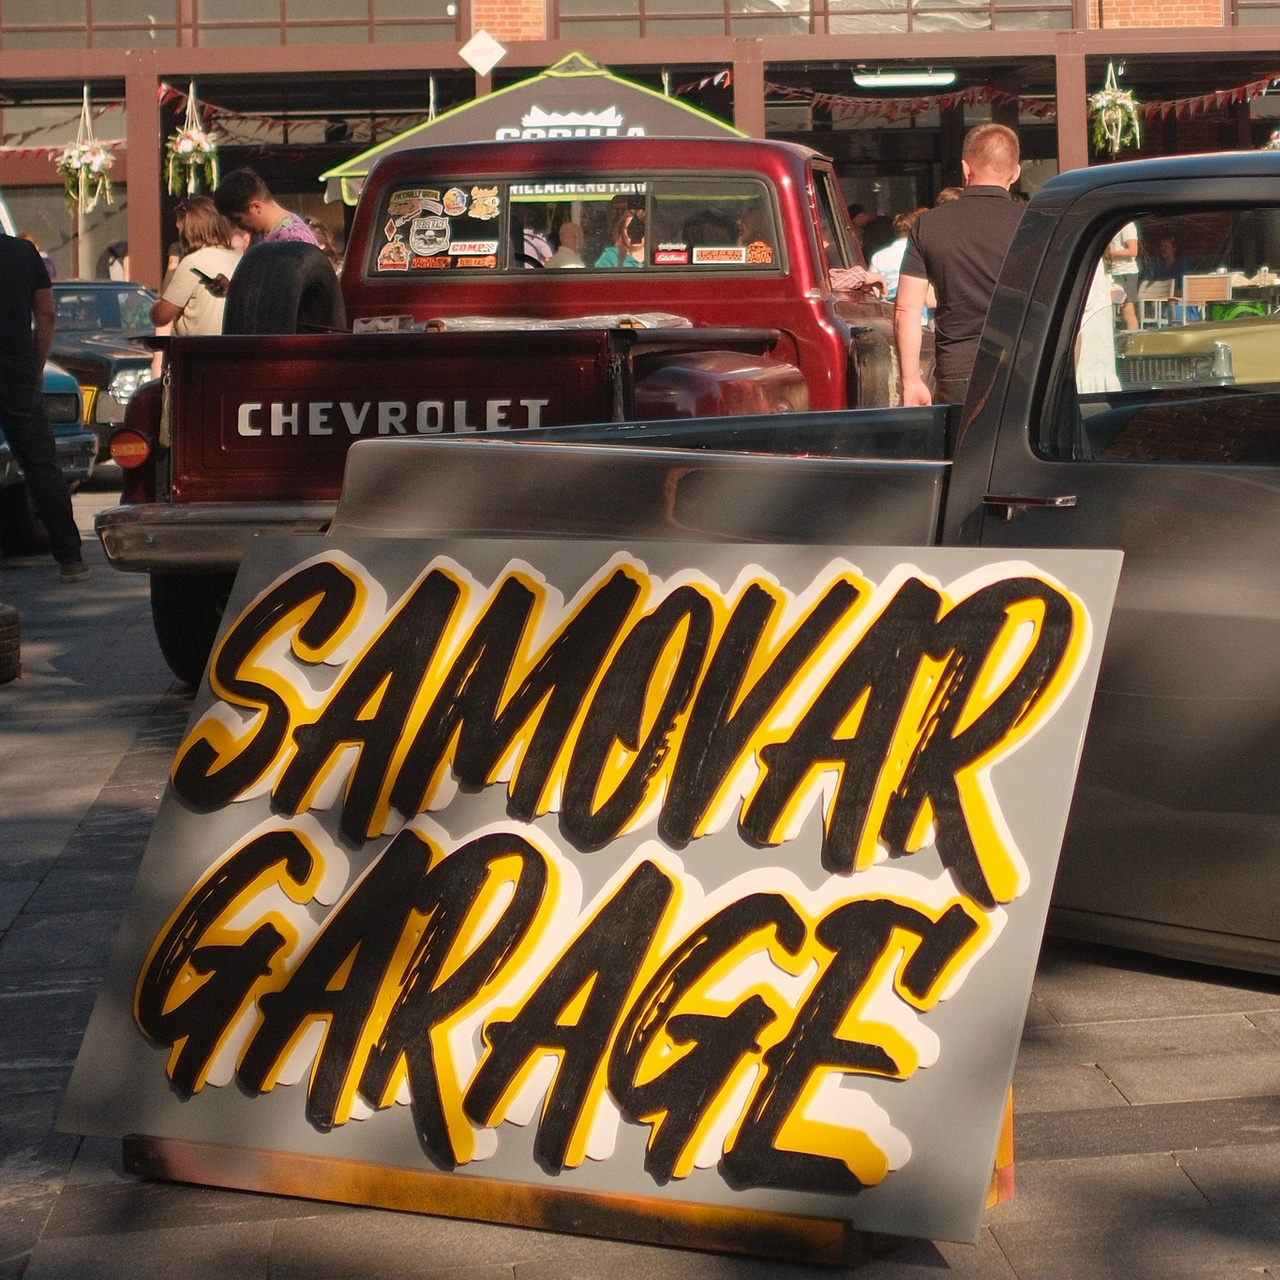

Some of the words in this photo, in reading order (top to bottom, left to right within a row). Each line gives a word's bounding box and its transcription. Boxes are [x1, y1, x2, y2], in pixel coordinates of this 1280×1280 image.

[451, 243, 485, 252] COMP
[237, 398, 549, 437] CHEVROLET
[171, 556, 1093, 906] SAMOVAR
[134, 827, 1000, 1191] GARAGE
